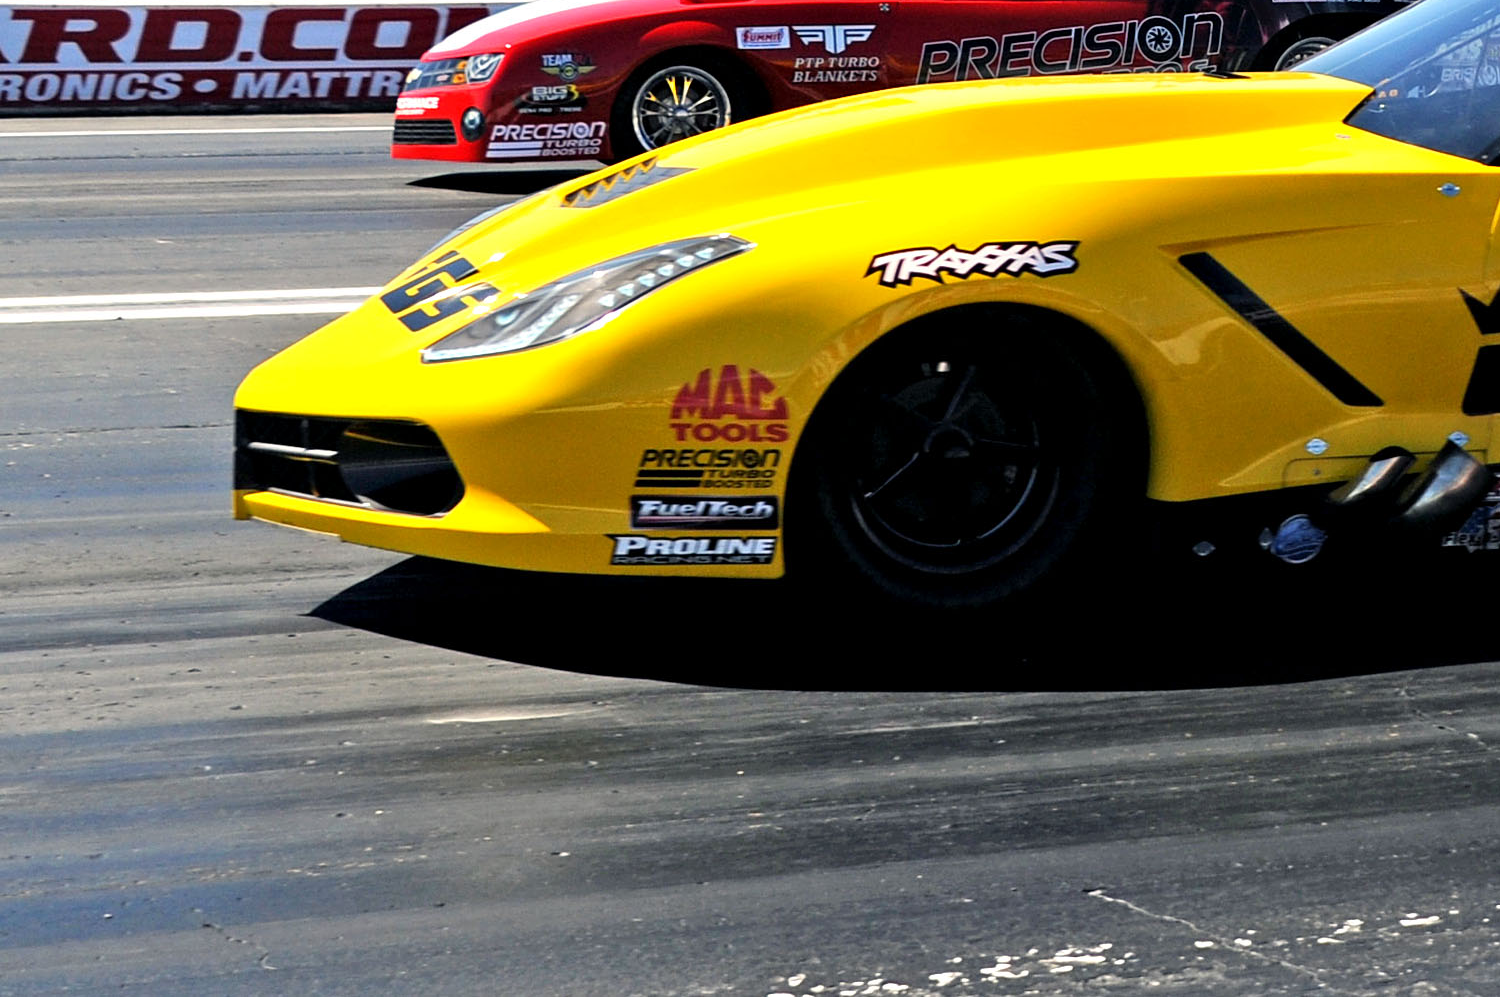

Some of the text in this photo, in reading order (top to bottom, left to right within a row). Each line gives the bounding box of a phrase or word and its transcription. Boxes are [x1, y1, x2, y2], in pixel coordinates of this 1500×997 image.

[0, 8, 490, 64] RD.CO
[918, 12, 1223, 85] PRECISION
[542, 54, 573, 67] TEAM
[794, 57, 880, 69] PTP TURBO
[793, 70, 877, 83] BLANKETS
[532, 84, 579, 102] BIG 3
[491, 121, 606, 141] PRECISION
[542, 148, 600, 156] BOOSTED
[545, 139, 602, 148] TURBO
[871, 243, 1077, 284] TRAXXAS
[381, 250, 500, 332] GS
[669, 364, 789, 419] MAC
[669, 423, 789, 442] TOOLS
[640, 448, 780, 468] PRECISION
[705, 469, 776, 479] TURBO
[703, 479, 773, 488] BOOSTED
[637, 500, 774, 518] FuelTech
[614, 536, 777, 555] PROLINE
